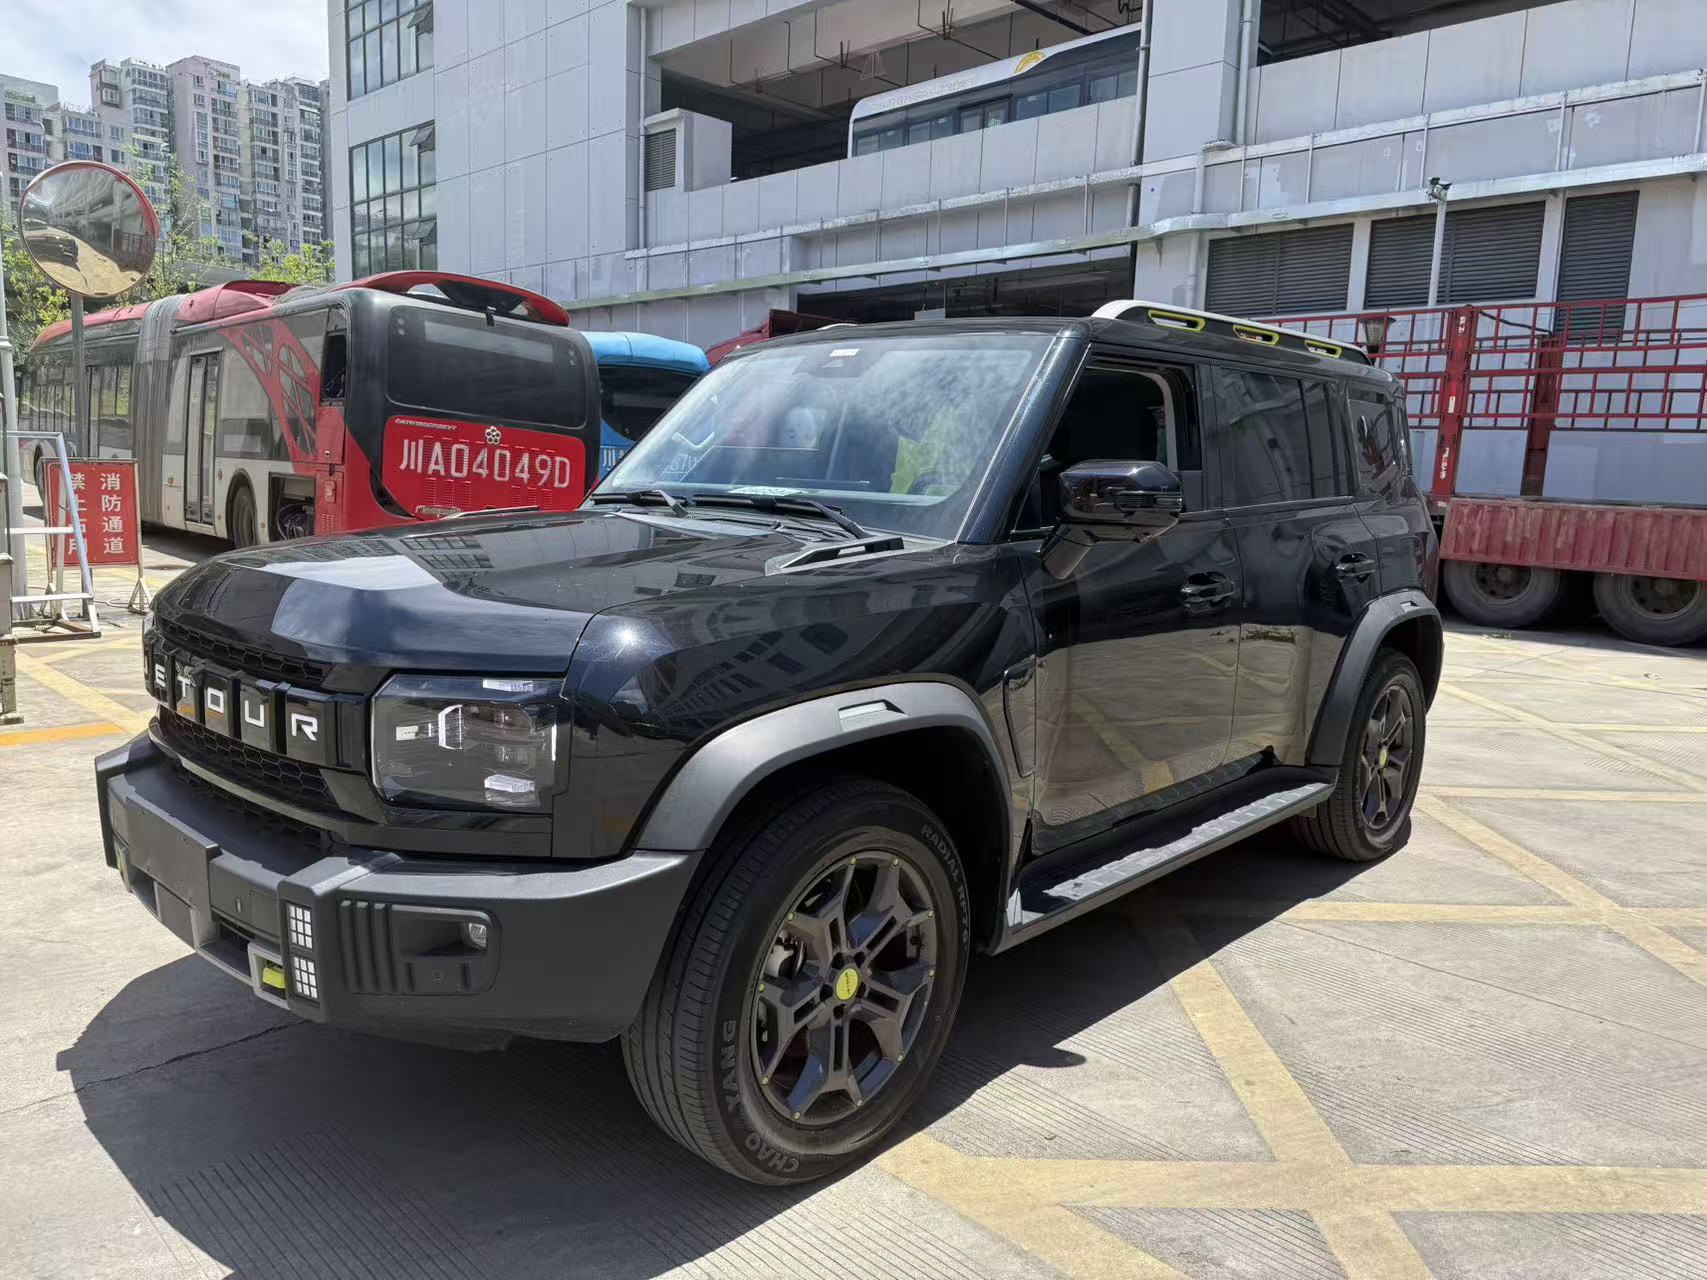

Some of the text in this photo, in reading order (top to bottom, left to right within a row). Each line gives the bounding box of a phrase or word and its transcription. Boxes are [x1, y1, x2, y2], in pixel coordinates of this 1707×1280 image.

[400, 438, 571, 489] 川A04049D
[99, 472, 125, 555] 消防通道
[920, 823, 960, 882] RADIAL
[720, 1019, 800, 1173] CHAO YANG
